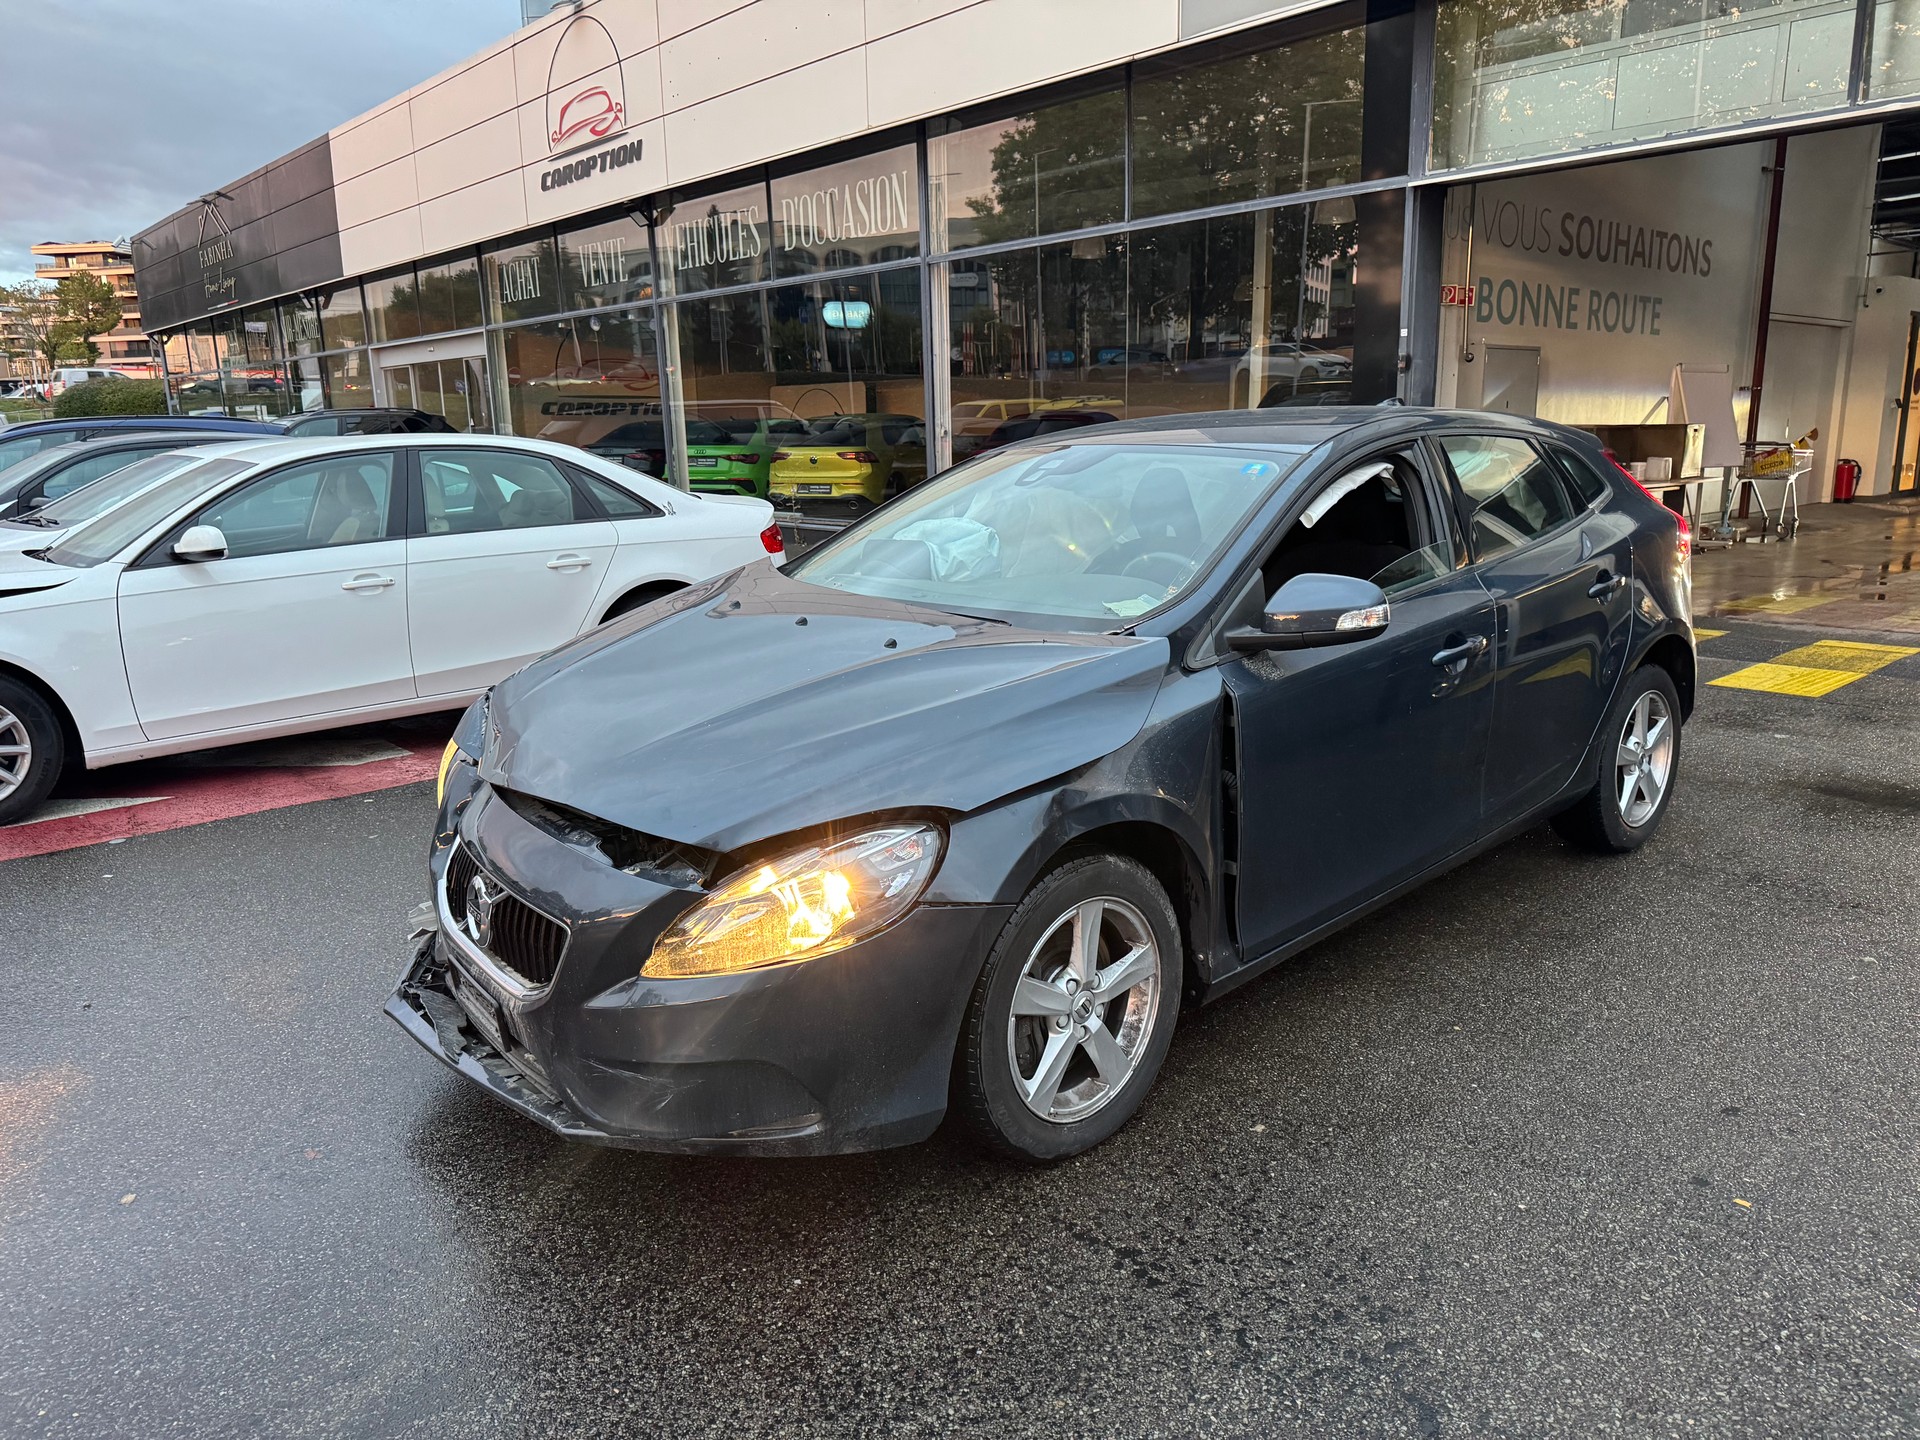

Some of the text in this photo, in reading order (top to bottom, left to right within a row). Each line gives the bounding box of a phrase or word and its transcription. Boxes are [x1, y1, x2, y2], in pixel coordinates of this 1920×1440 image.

[541, 139, 643, 192] CAROPTION
[199, 240, 234, 269] FABINHA
[502, 256, 541, 304] ACHAT
[578, 237, 628, 288] VENTE
[782, 170, 908, 252] D'OCCASION
[1481, 197, 1552, 254] VOUS
[1558, 212, 1712, 277] SOUHAITONS
[1476, 277, 1663, 336] BONNE ROUTE
